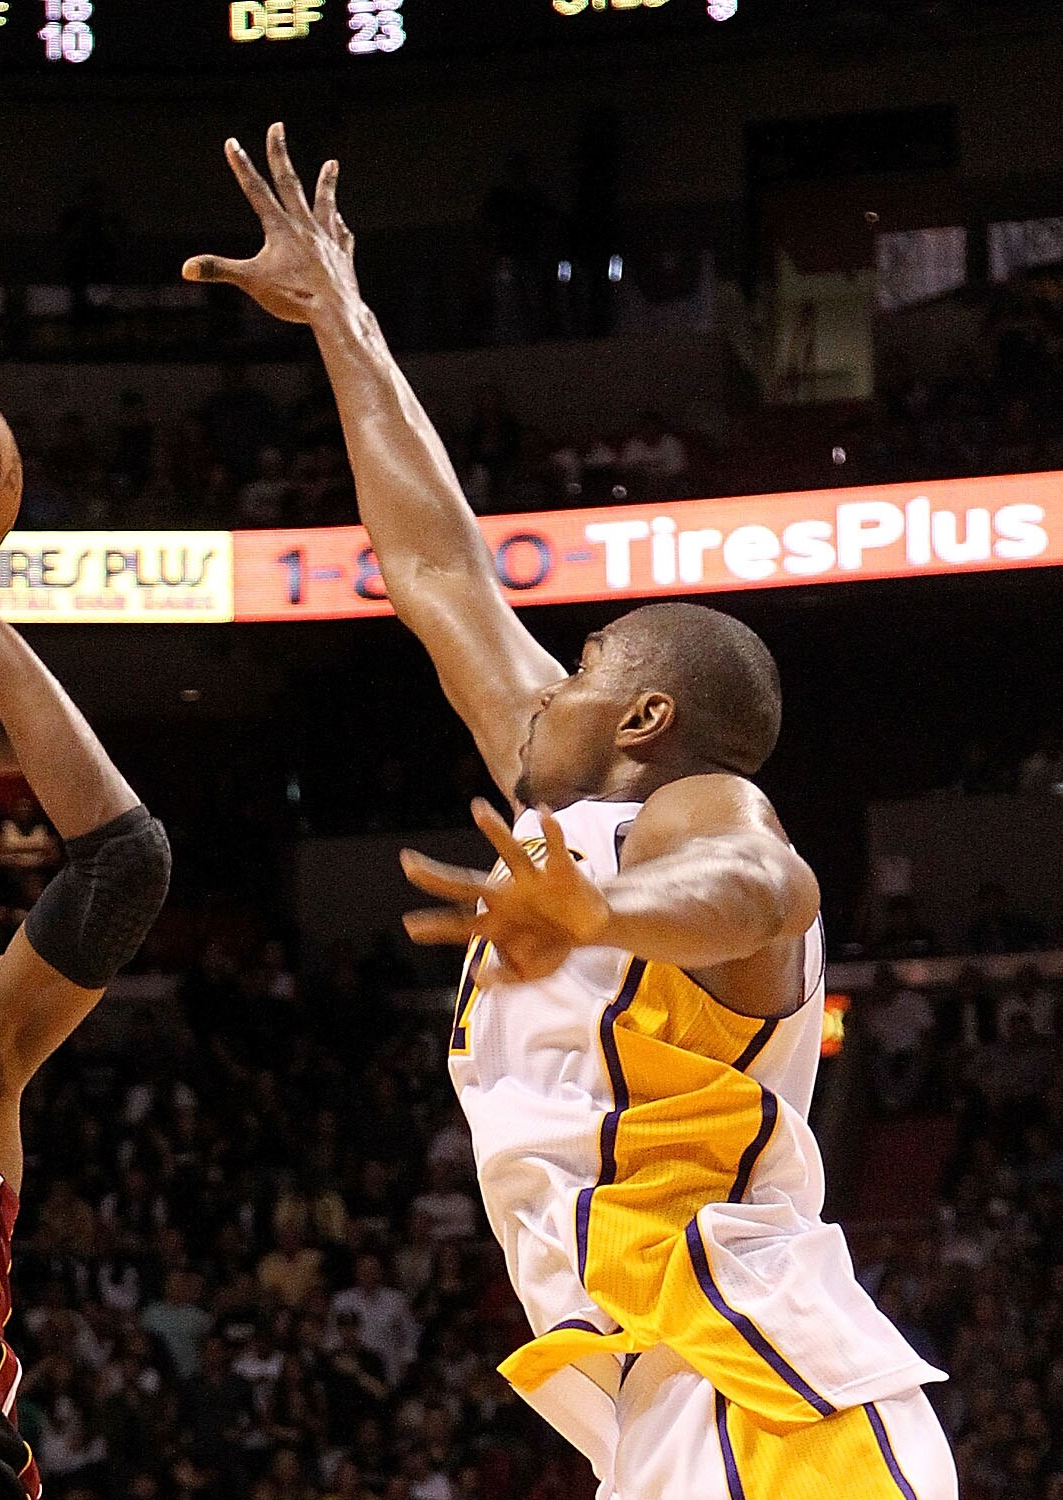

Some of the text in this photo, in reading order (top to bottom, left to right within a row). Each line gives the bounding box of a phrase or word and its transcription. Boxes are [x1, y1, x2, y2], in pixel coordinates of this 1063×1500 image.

[37, 21, 94, 63] 10
[229, 0, 325, 42] DEF
[348, 10, 406, 55] 23
[104, 549, 216, 588] PLUS
